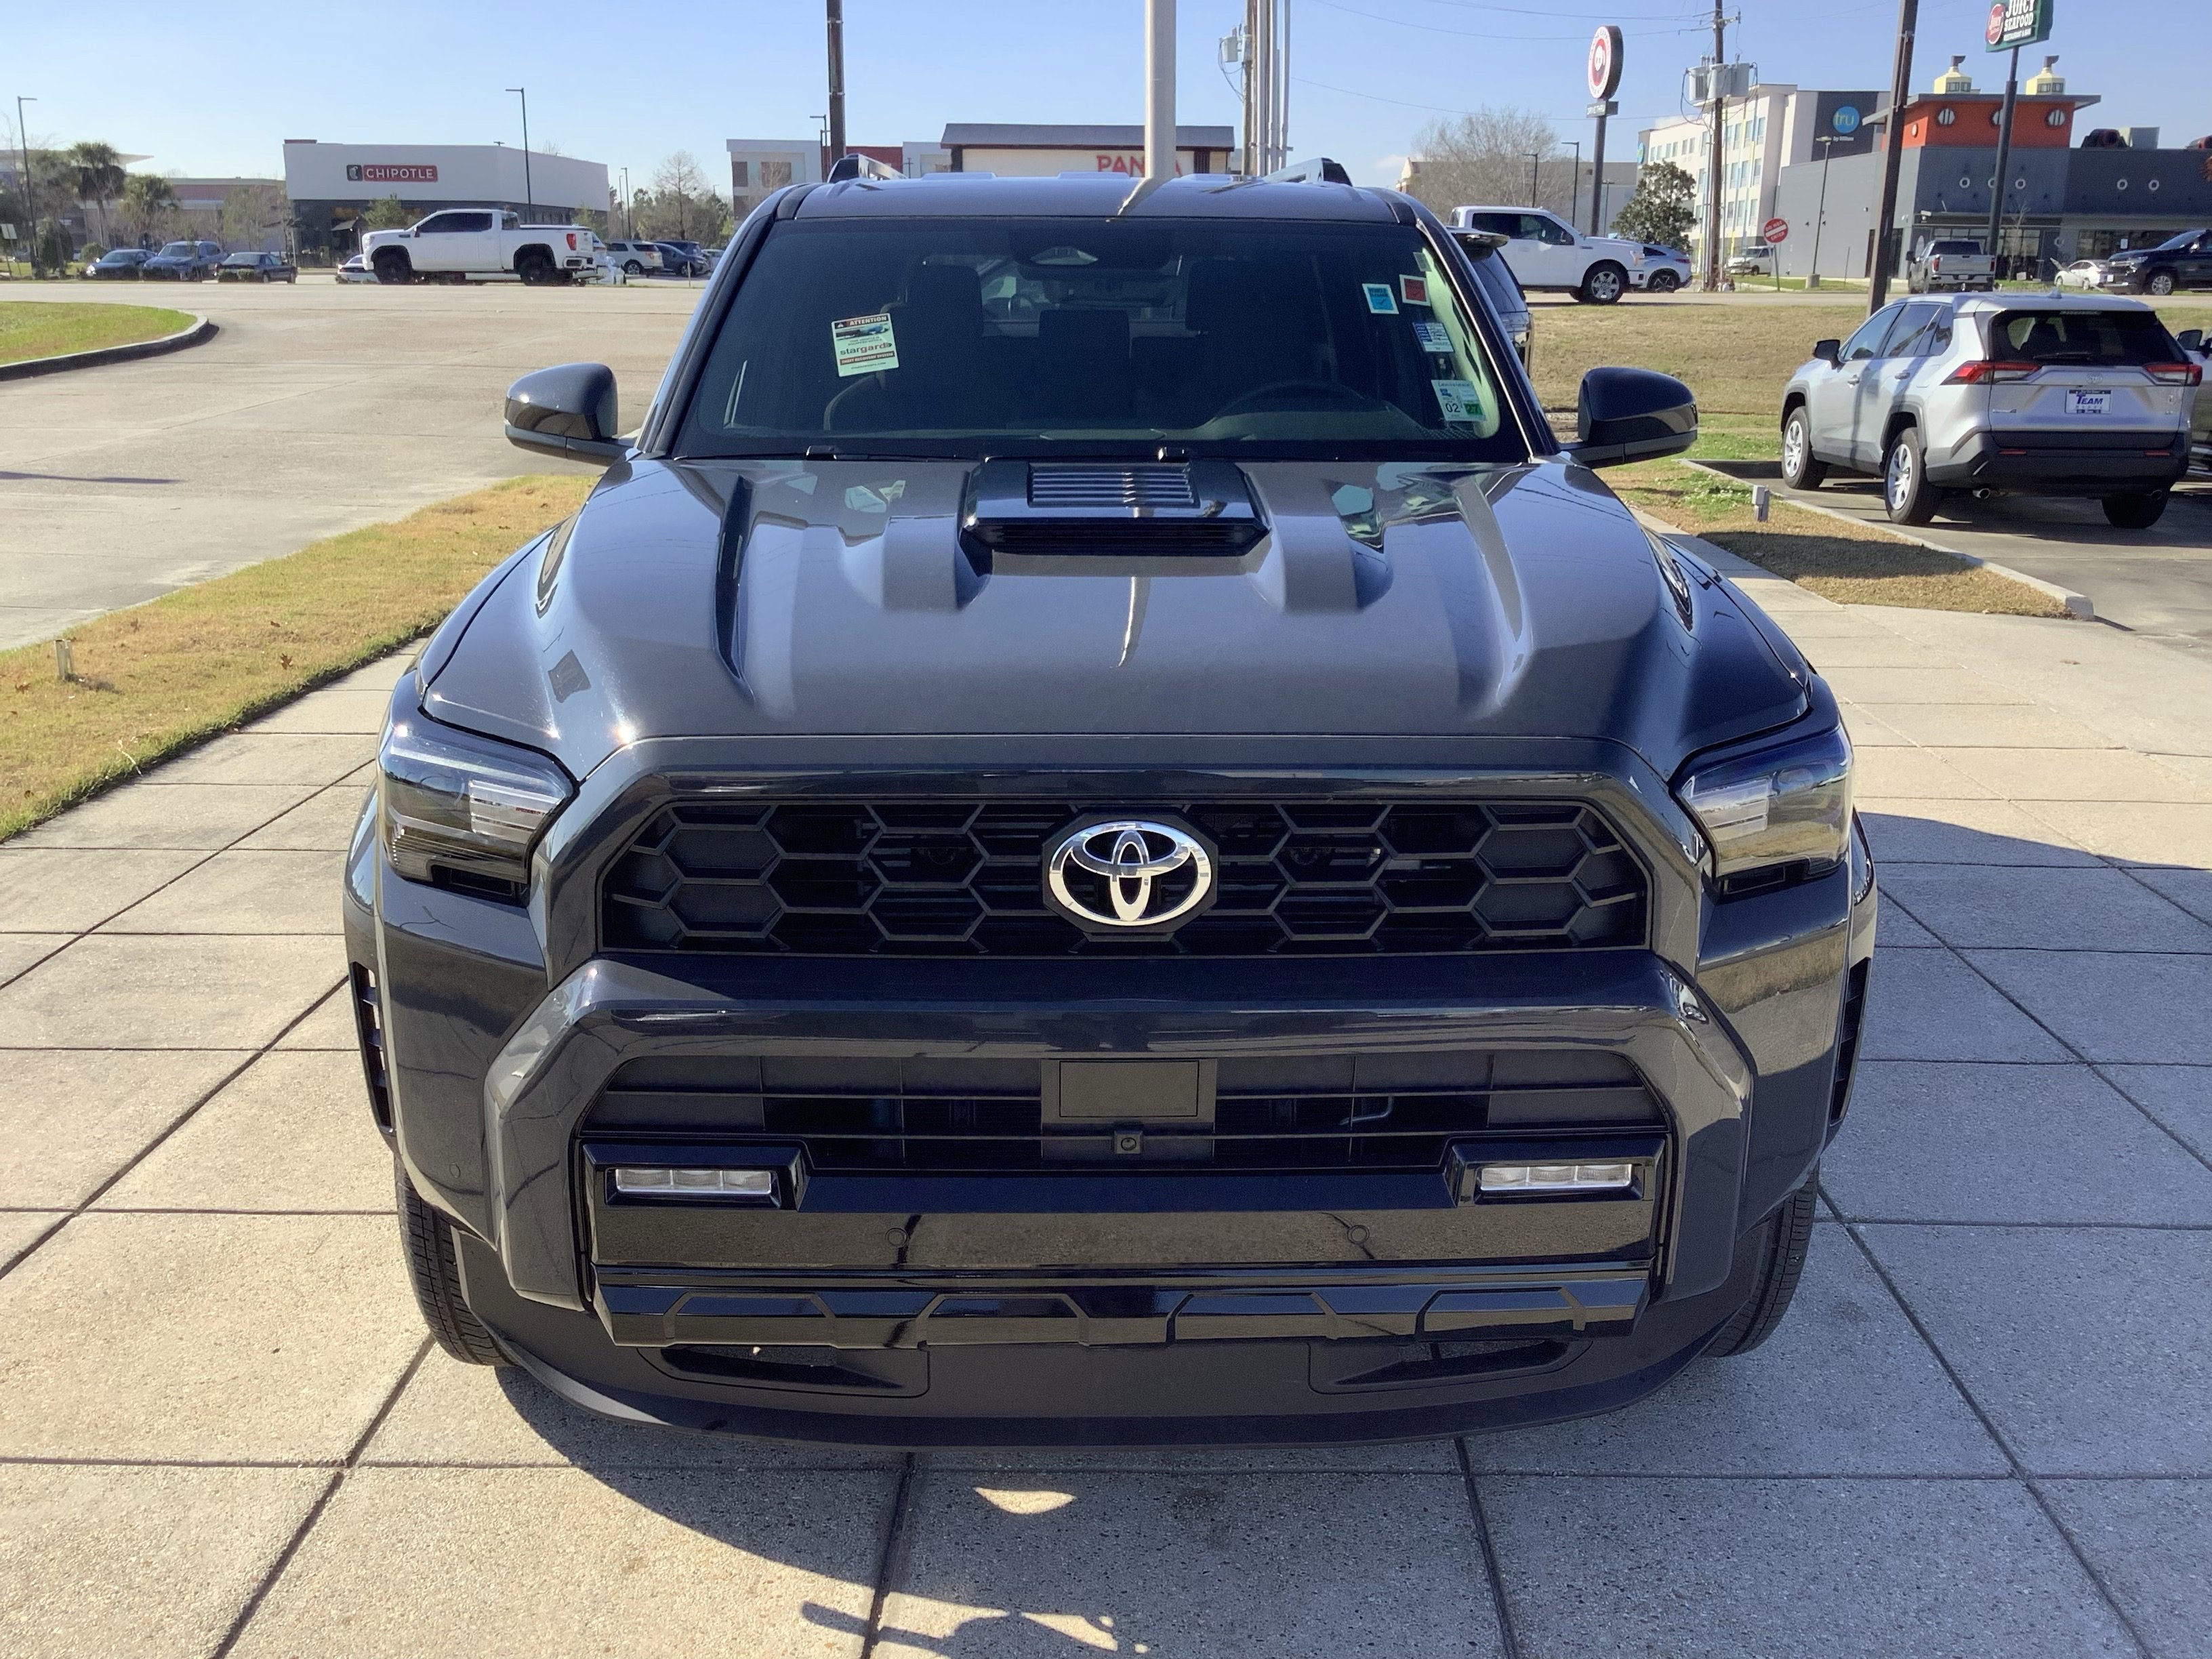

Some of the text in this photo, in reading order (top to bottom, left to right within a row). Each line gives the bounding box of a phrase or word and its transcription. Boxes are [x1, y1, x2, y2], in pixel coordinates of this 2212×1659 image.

[2006, 0, 2034, 18] JUICY
[2004, 12, 2034, 32] SEAFOOD
[1835, 111, 1854, 125] tru
[366, 168, 434, 178] CHIPOTLE
[849, 316, 886, 326] ATTENTION
[840, 342, 886, 355] stargard
[1445, 403, 1460, 413] 02
